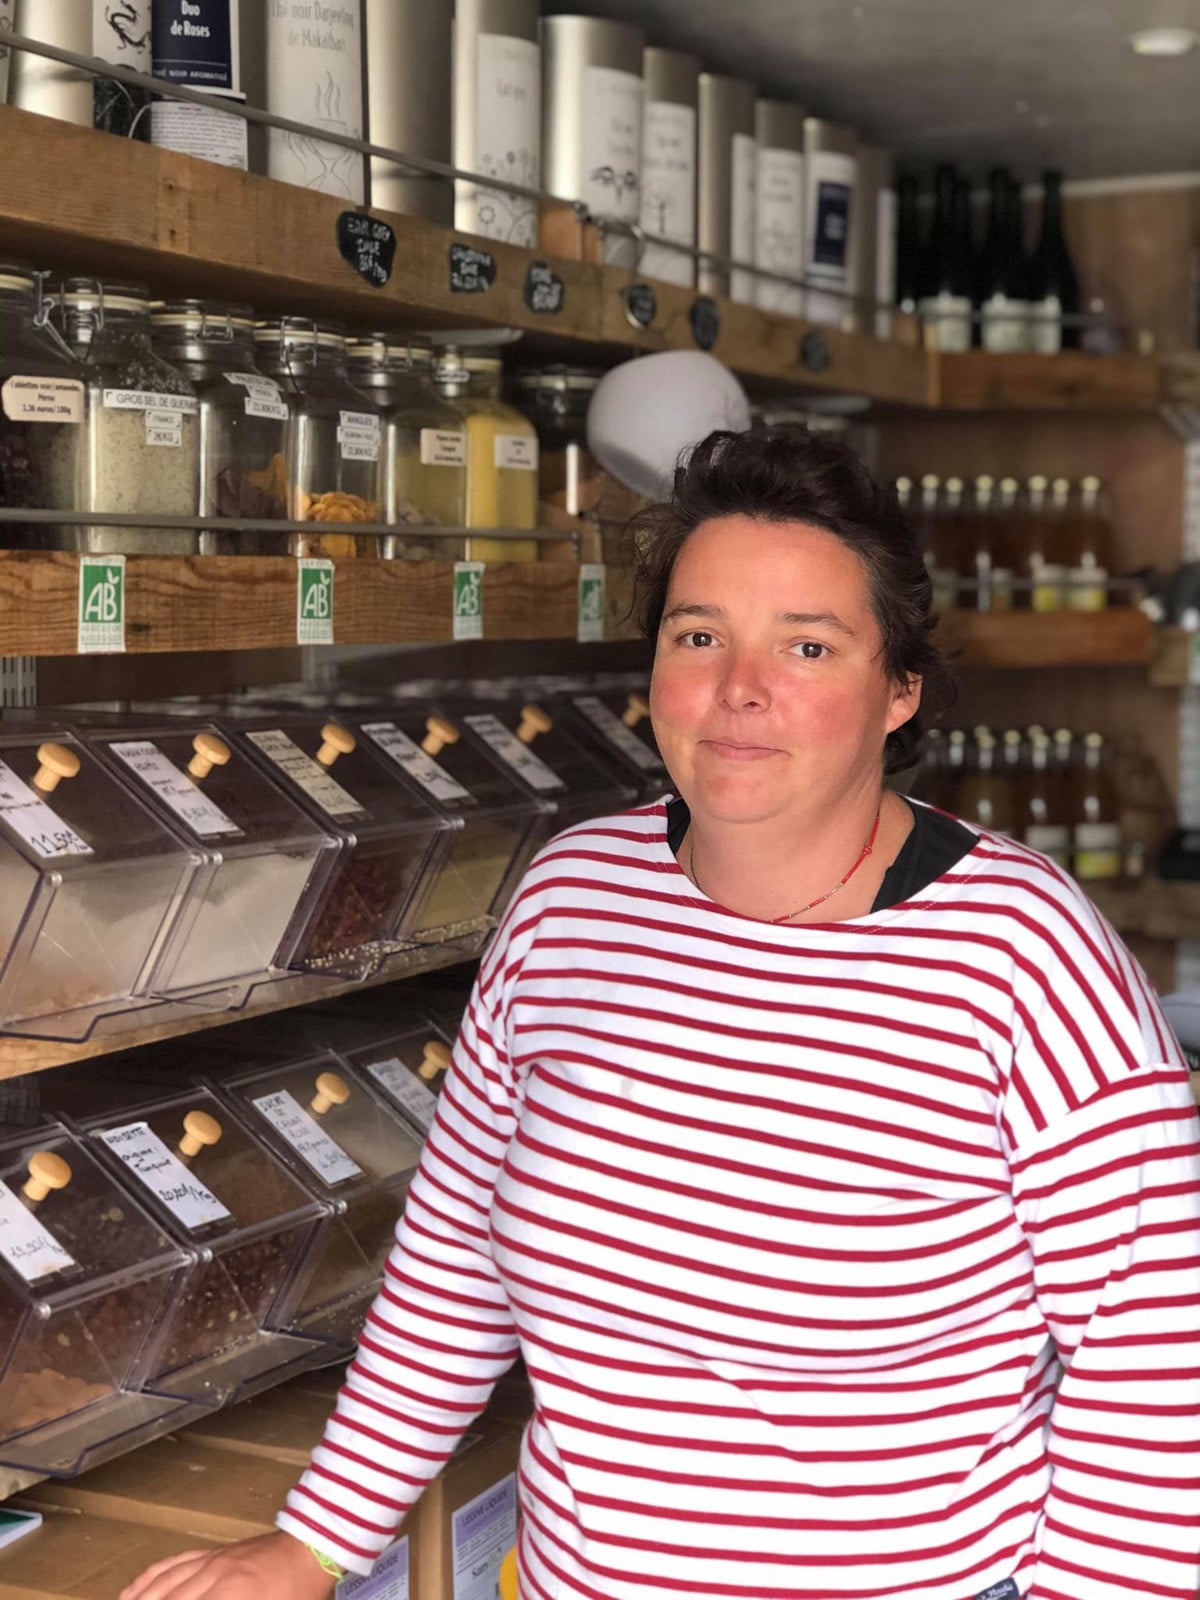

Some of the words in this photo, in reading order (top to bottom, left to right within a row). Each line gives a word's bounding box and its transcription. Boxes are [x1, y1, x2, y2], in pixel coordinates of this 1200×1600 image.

[181, 0, 201, 16] Duo
[169, 19, 183, 36] de
[183, 20, 211, 38] Roses
[168, 69, 189, 78] NOIR
[116, 393, 143, 405] GROS
[143, 395, 158, 407] SEL
[159, 397, 169, 407] DE
[85, 582, 118, 621] AB
[303, 583, 329, 618] AB
[462, 1505, 485, 1527] LESSIVE
[485, 1489, 508, 1512] LIQUIDE
